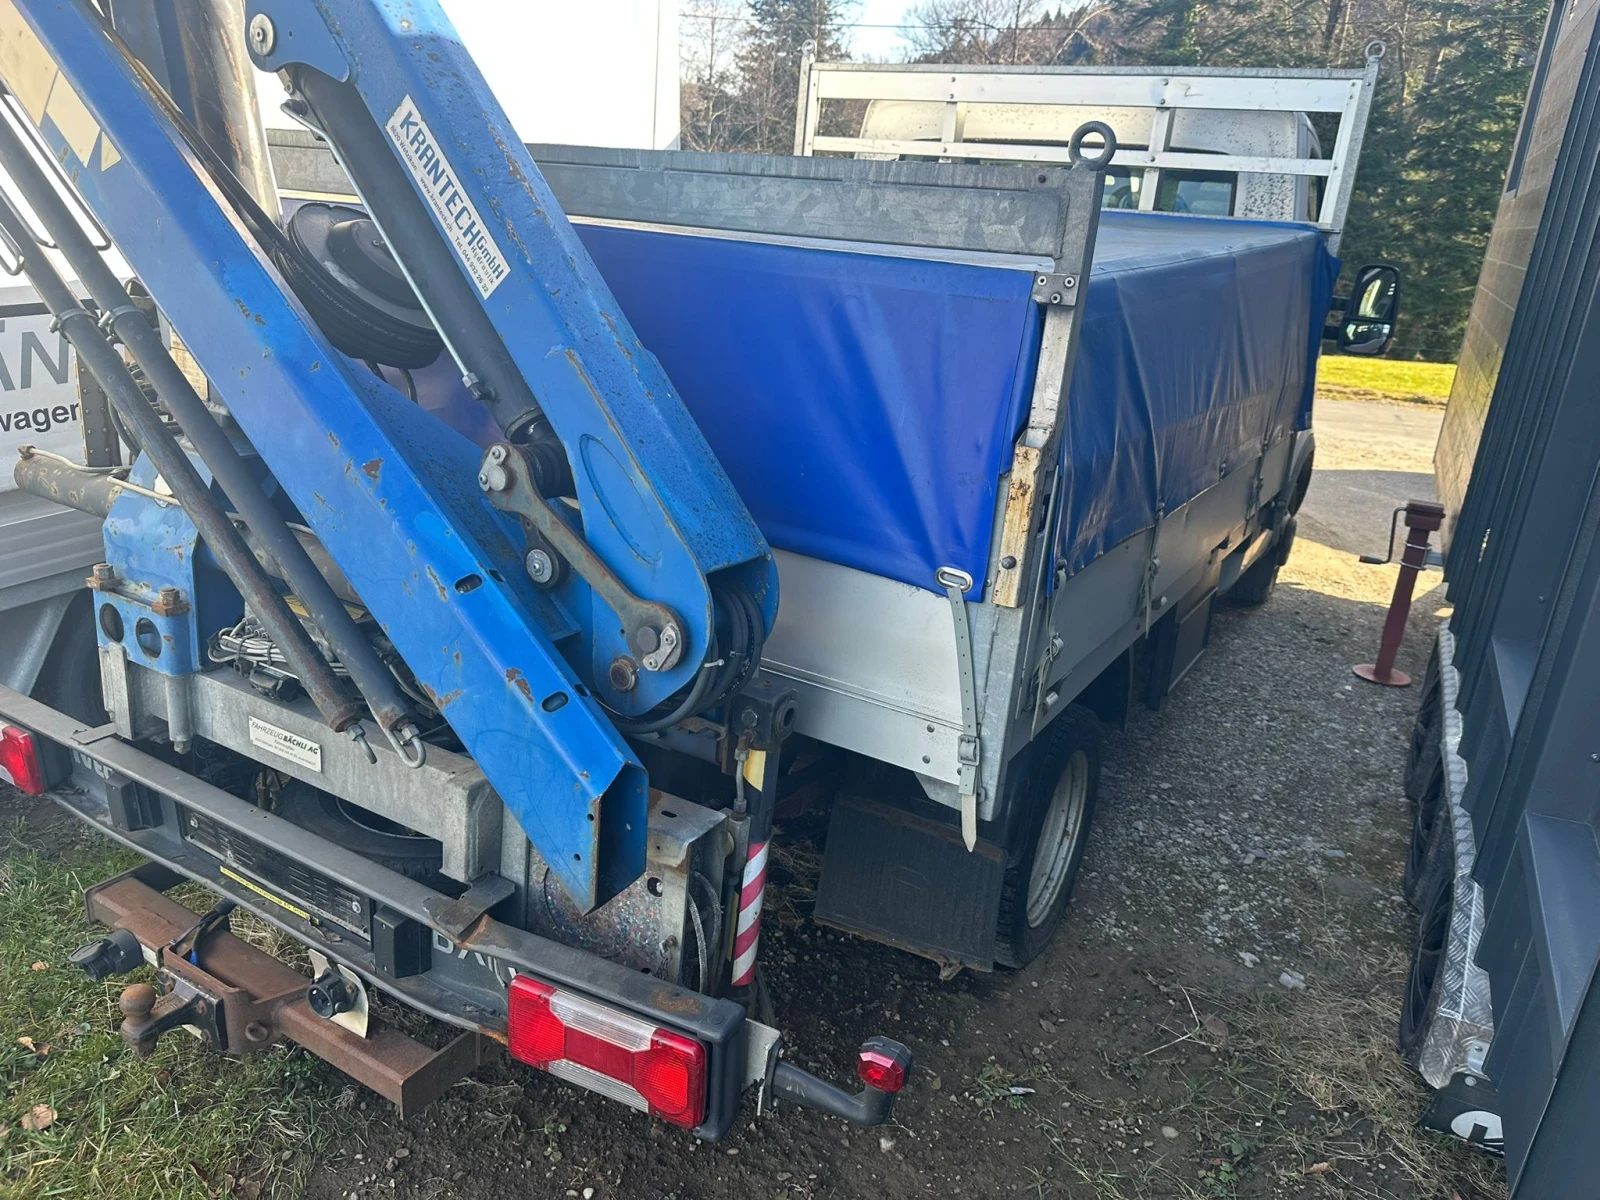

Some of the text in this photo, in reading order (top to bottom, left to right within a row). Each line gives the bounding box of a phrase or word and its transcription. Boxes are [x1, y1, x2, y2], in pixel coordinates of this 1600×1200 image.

[400, 142, 418, 171] Wetzikon
[400, 111, 504, 280] KRANTECH GmbH
[471, 245, 494, 285] Hydraulik
[307, 746, 318, 755] AG
